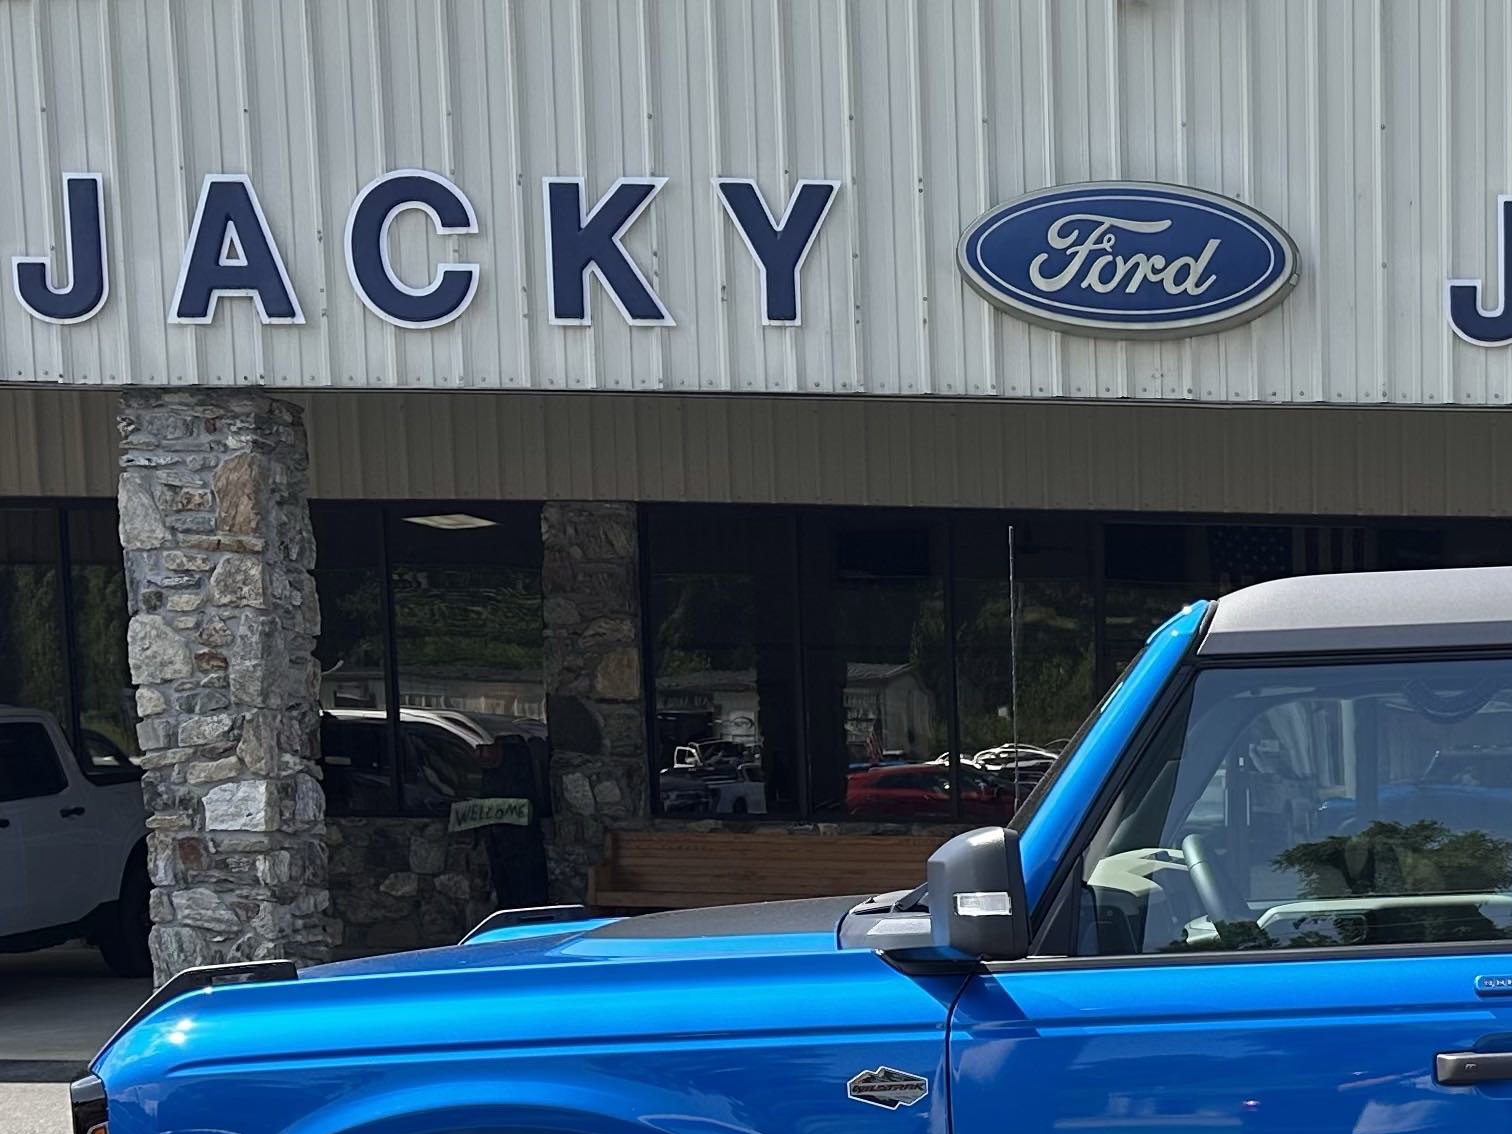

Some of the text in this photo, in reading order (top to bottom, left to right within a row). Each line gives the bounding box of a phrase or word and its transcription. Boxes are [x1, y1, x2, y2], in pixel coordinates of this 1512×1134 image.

[11, 169, 842, 329] JACKY
[1029, 213, 1222, 297] Ford
[455, 803, 526, 826] WELCOME
[852, 1083, 923, 1093] WILDTRAK
